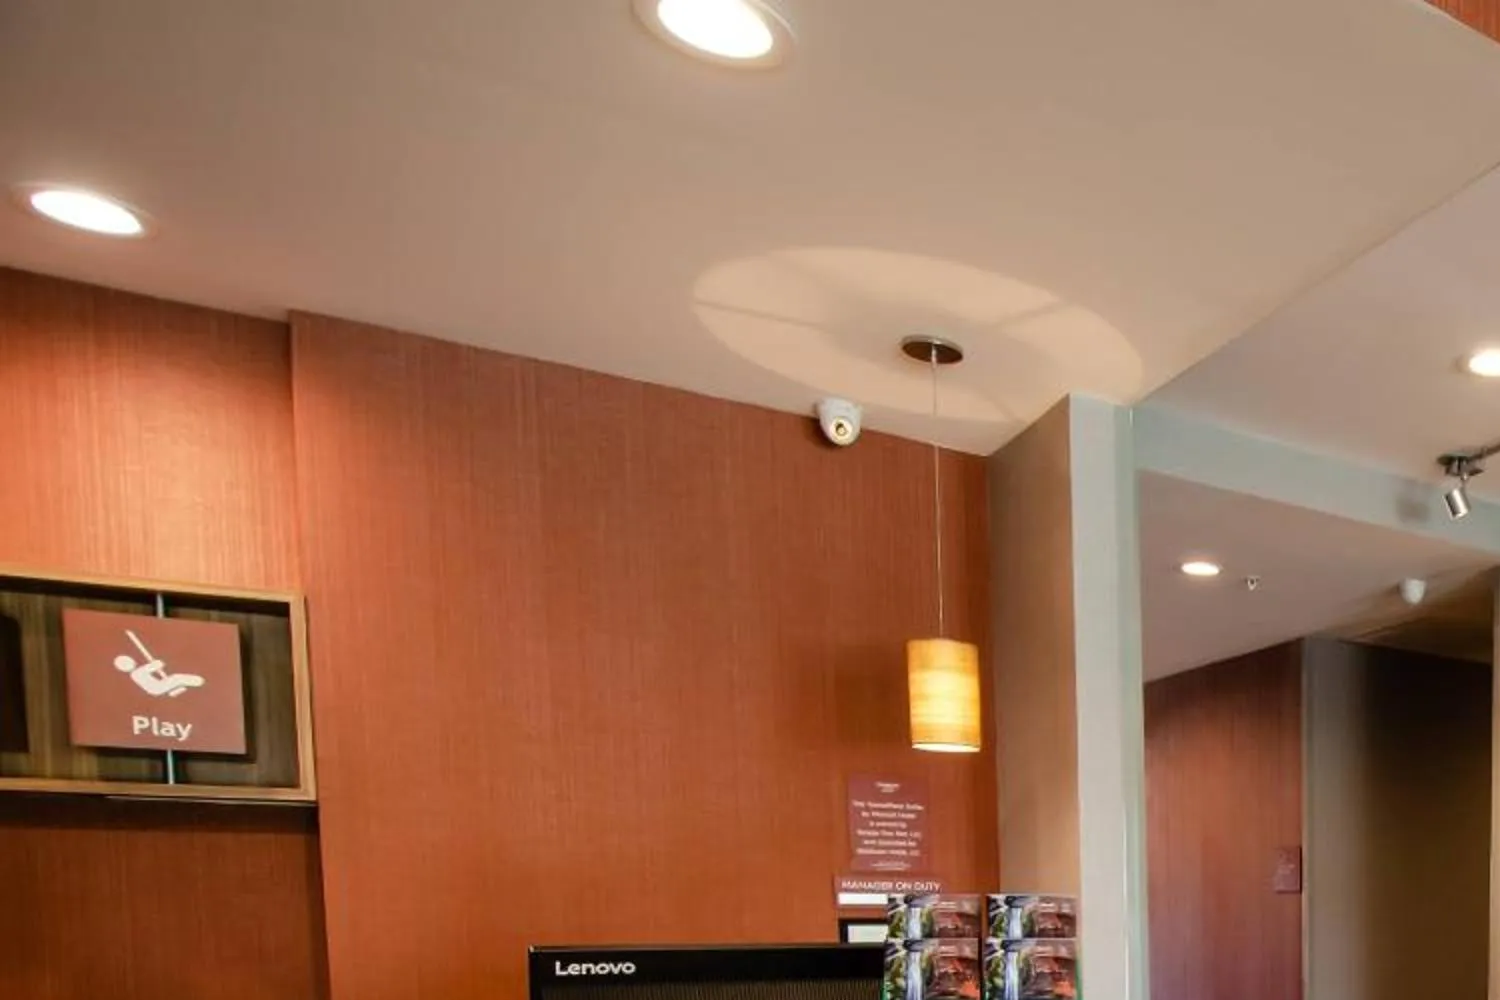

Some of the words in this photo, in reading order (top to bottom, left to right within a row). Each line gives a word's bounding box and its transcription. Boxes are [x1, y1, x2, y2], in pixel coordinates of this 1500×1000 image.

[132, 715, 192, 741] Play
[841, 881, 893, 890] MANAGER
[895, 881, 914, 891] ON
[916, 882, 941, 891] DUTY
[555, 960, 637, 976] Lenovo
